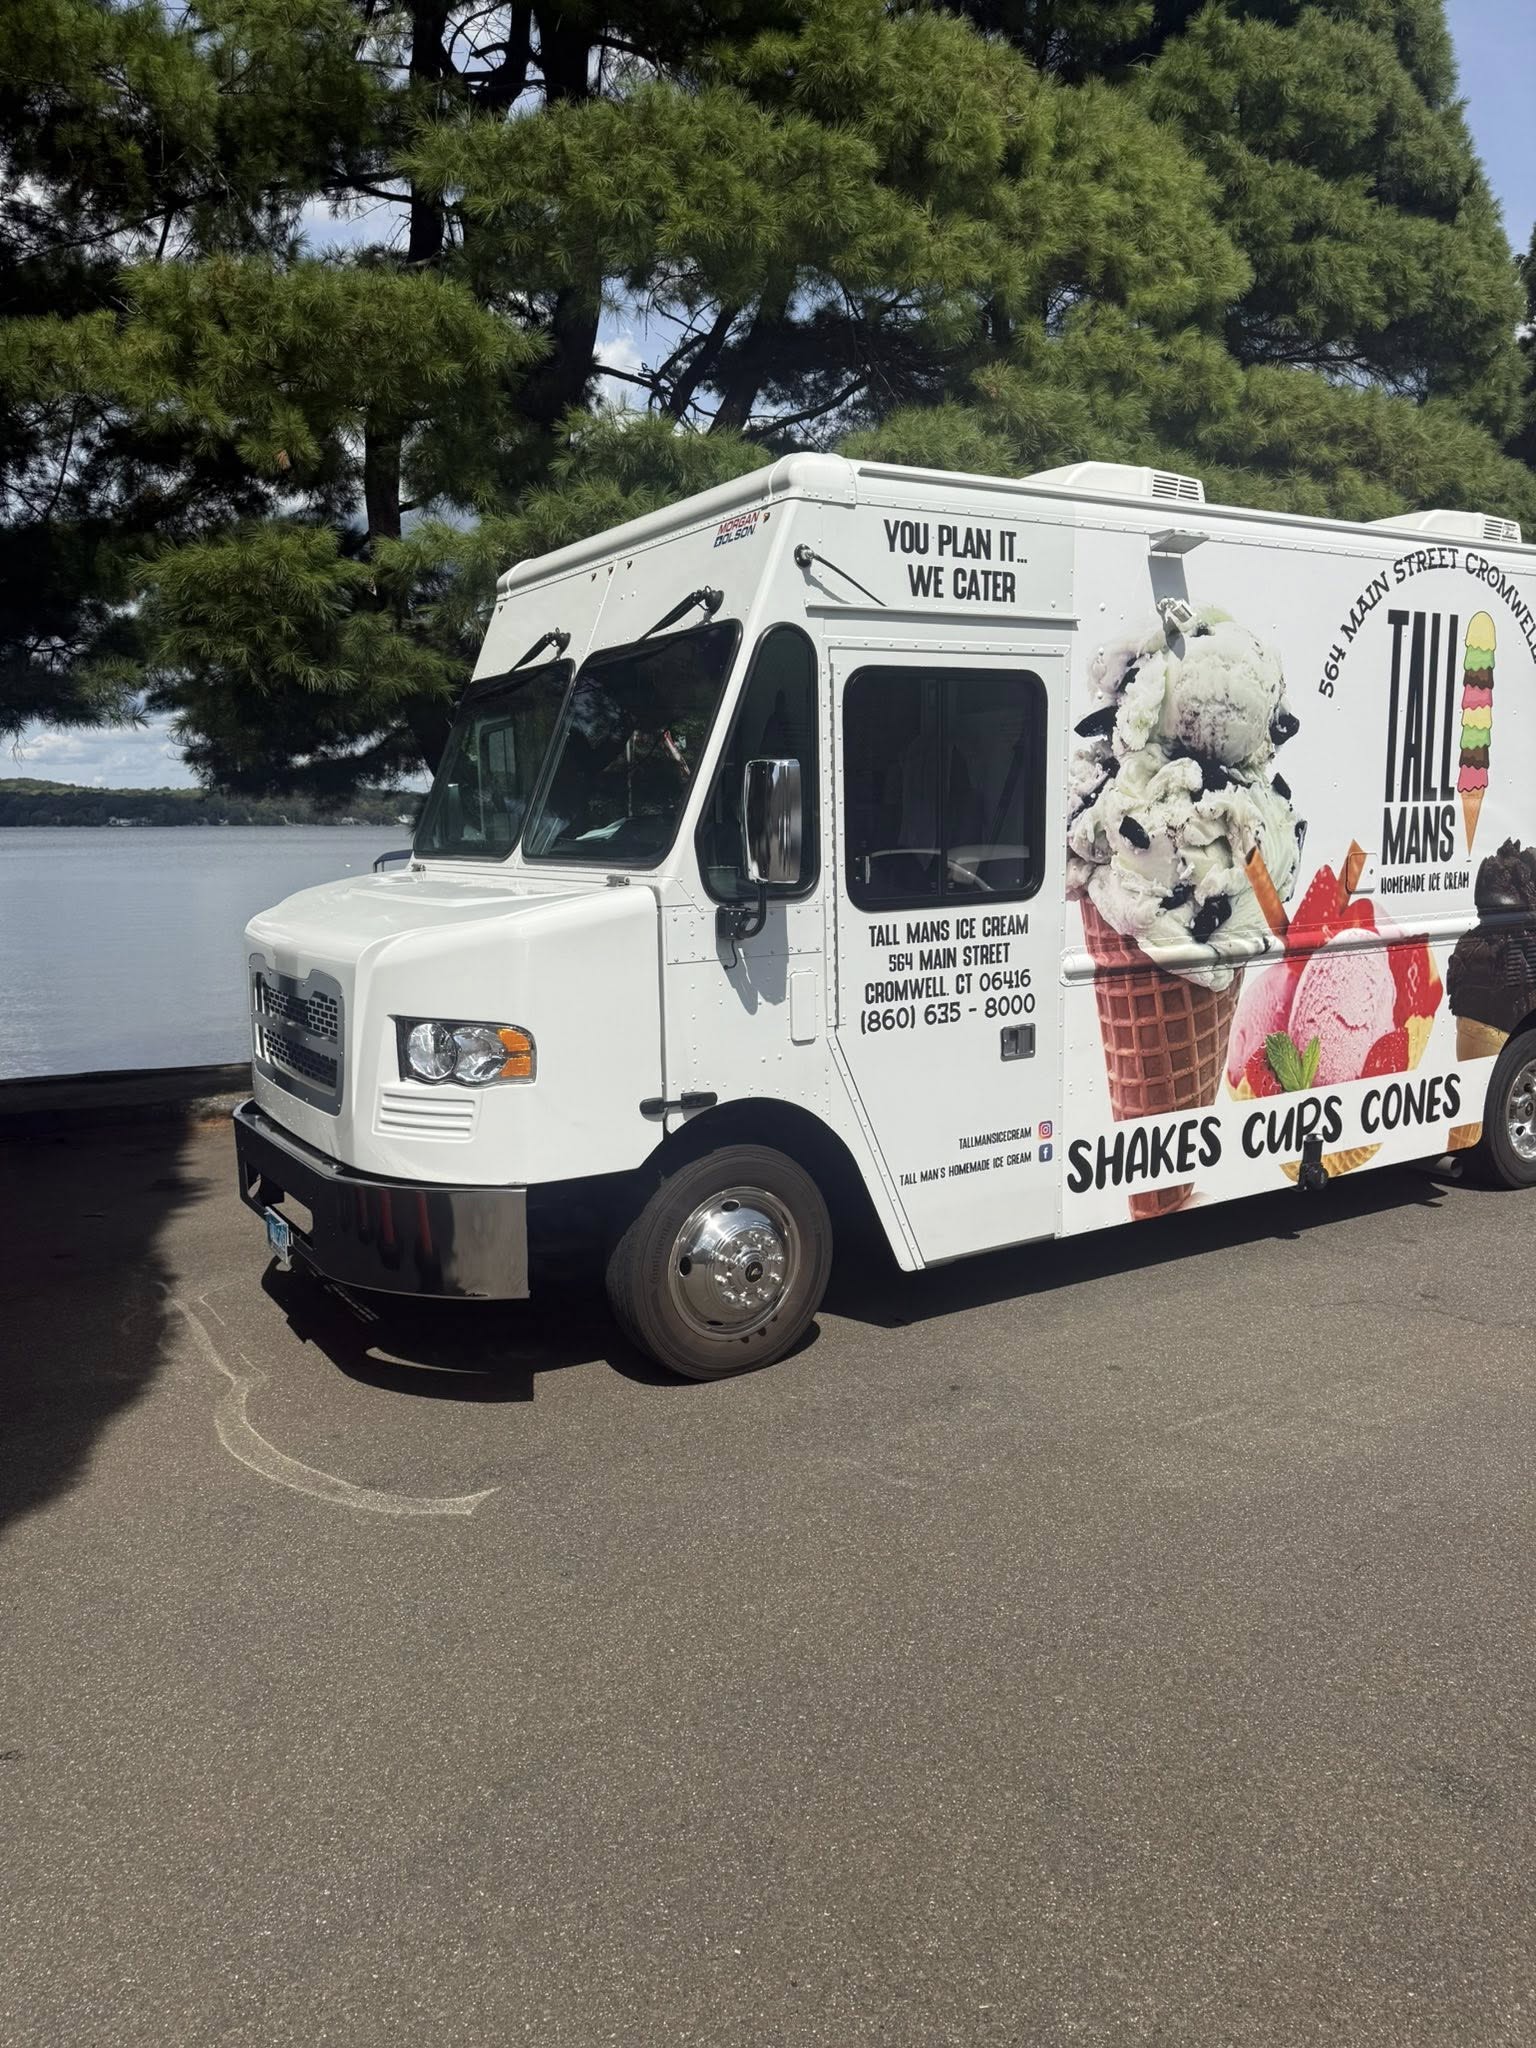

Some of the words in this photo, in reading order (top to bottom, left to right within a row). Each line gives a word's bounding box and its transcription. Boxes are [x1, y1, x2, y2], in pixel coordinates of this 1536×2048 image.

[717, 511, 760, 535] MORGAN
[883, 519, 930, 555] YOU
[938, 524, 992, 561] PLAN
[1000, 530, 1028, 564] IT...
[907, 564, 944, 598] WE
[952, 567, 1016, 602] CATER
[1318, 644, 1346, 698] 564
[1340, 570, 1390, 643] MAIN
[1393, 547, 1459, 584] STREET
[1384, 609, 1459, 803] TALL
[1381, 804, 1456, 865] MANS
[1381, 873, 1426, 895] HOMEMADE
[1428, 872, 1441, 892] ICE
[1444, 871, 1470, 891] CREAM
[868, 923, 900, 948] TALL
[906, 919, 950, 944] MANS
[956, 917, 977, 940] ICE
[982, 913, 1029, 938] CREAM
[889, 952, 913, 973] 564
[919, 947, 957, 971] MAIN
[963, 942, 1010, 967] STREET
[955, 973, 973, 995] CT
[979, 968, 1032, 992] 06416
[861, 1004, 916, 1035] (860)
[924, 1001, 961, 1026] 635
[984, 993, 1036, 1019] 8000
[958, 1127, 1032, 1150] TALLMANSICECREAM
[1067, 1116, 1222, 1194] SHAKES
[1242, 1095, 1343, 1159] CUPS
[1360, 1073, 1461, 1134] CONES
[899, 1172, 917, 1187] TALL
[920, 1167, 946, 1183] MAN'S
[948, 1158, 990, 1177] HOMEMADE
[993, 1156, 1004, 1169] ICE
[1006, 1151, 1032, 1166] CREAM
